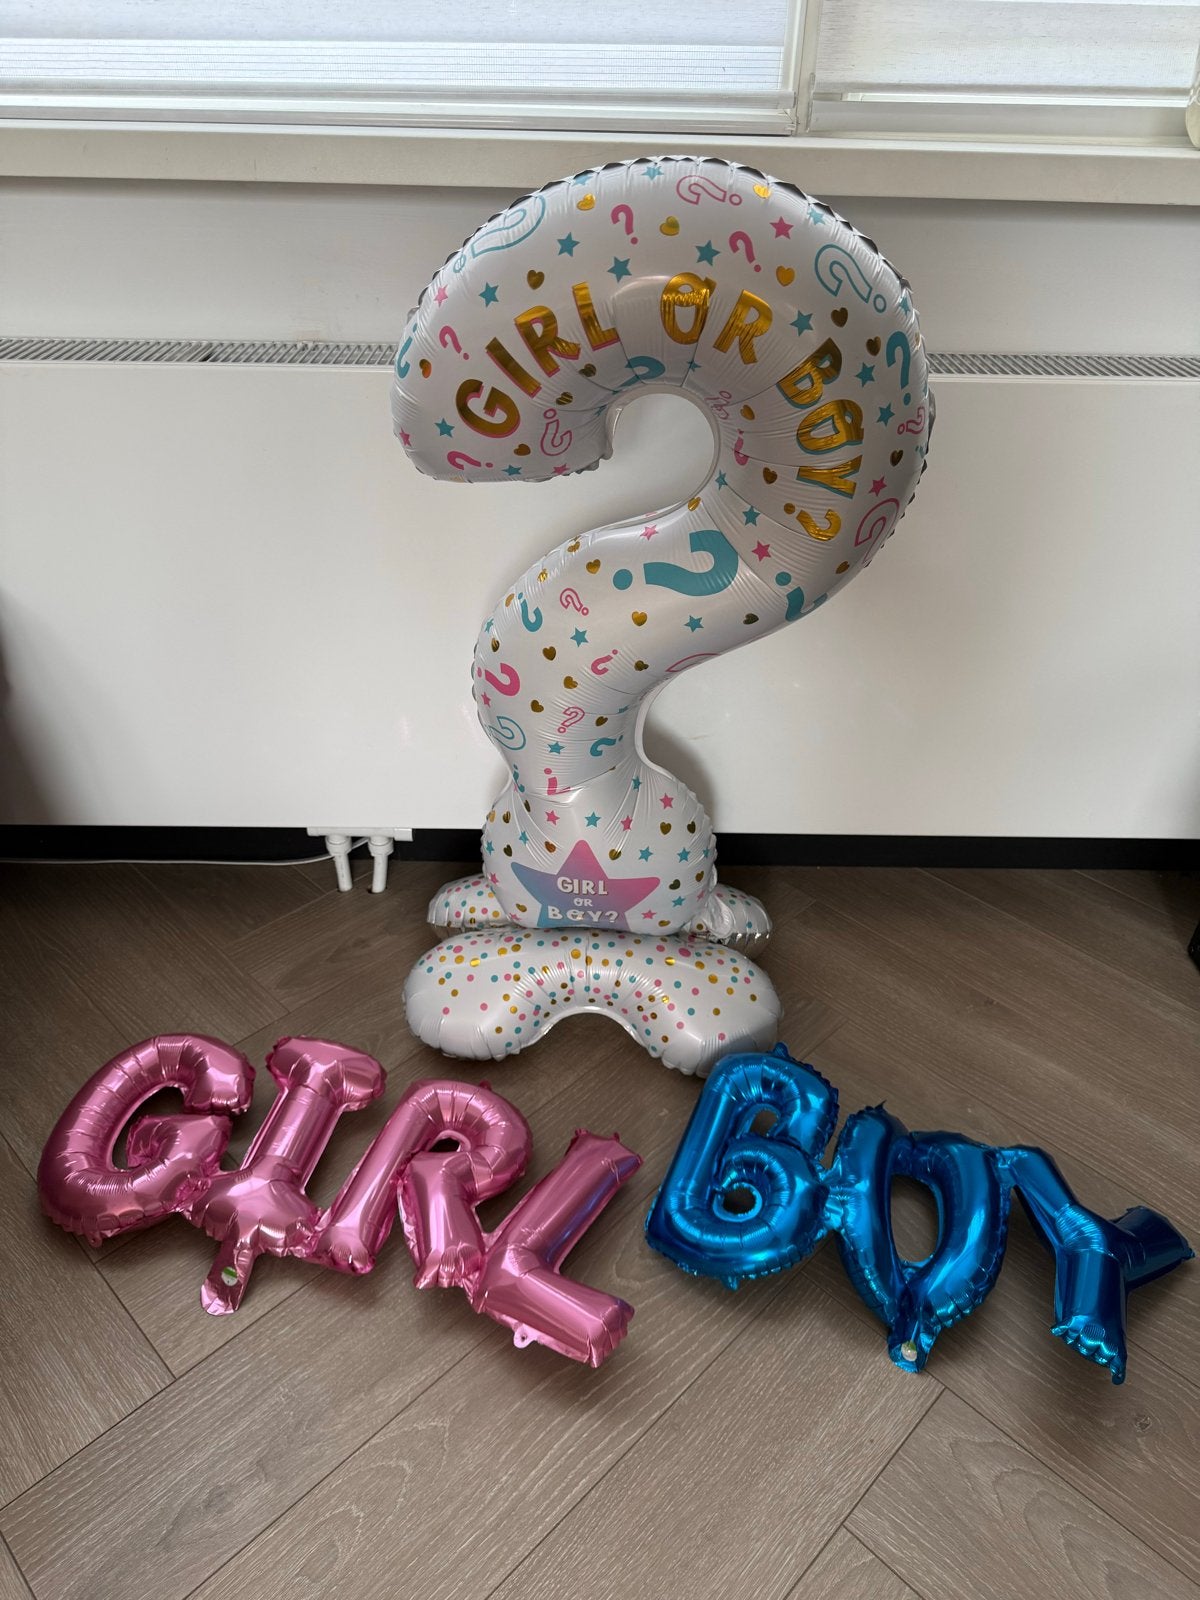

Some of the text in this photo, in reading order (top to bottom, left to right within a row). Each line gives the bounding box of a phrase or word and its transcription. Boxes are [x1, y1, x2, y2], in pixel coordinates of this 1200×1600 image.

[455, 281, 620, 438] GIRL
[659, 271, 774, 365] OR
[547, 905, 619, 923] BOY?
[557, 876, 608, 896] GIRL
[573, 897, 593, 906] OR
[37, 1033, 643, 1368] GIRL
[645, 1043, 1195, 1385] BOY
